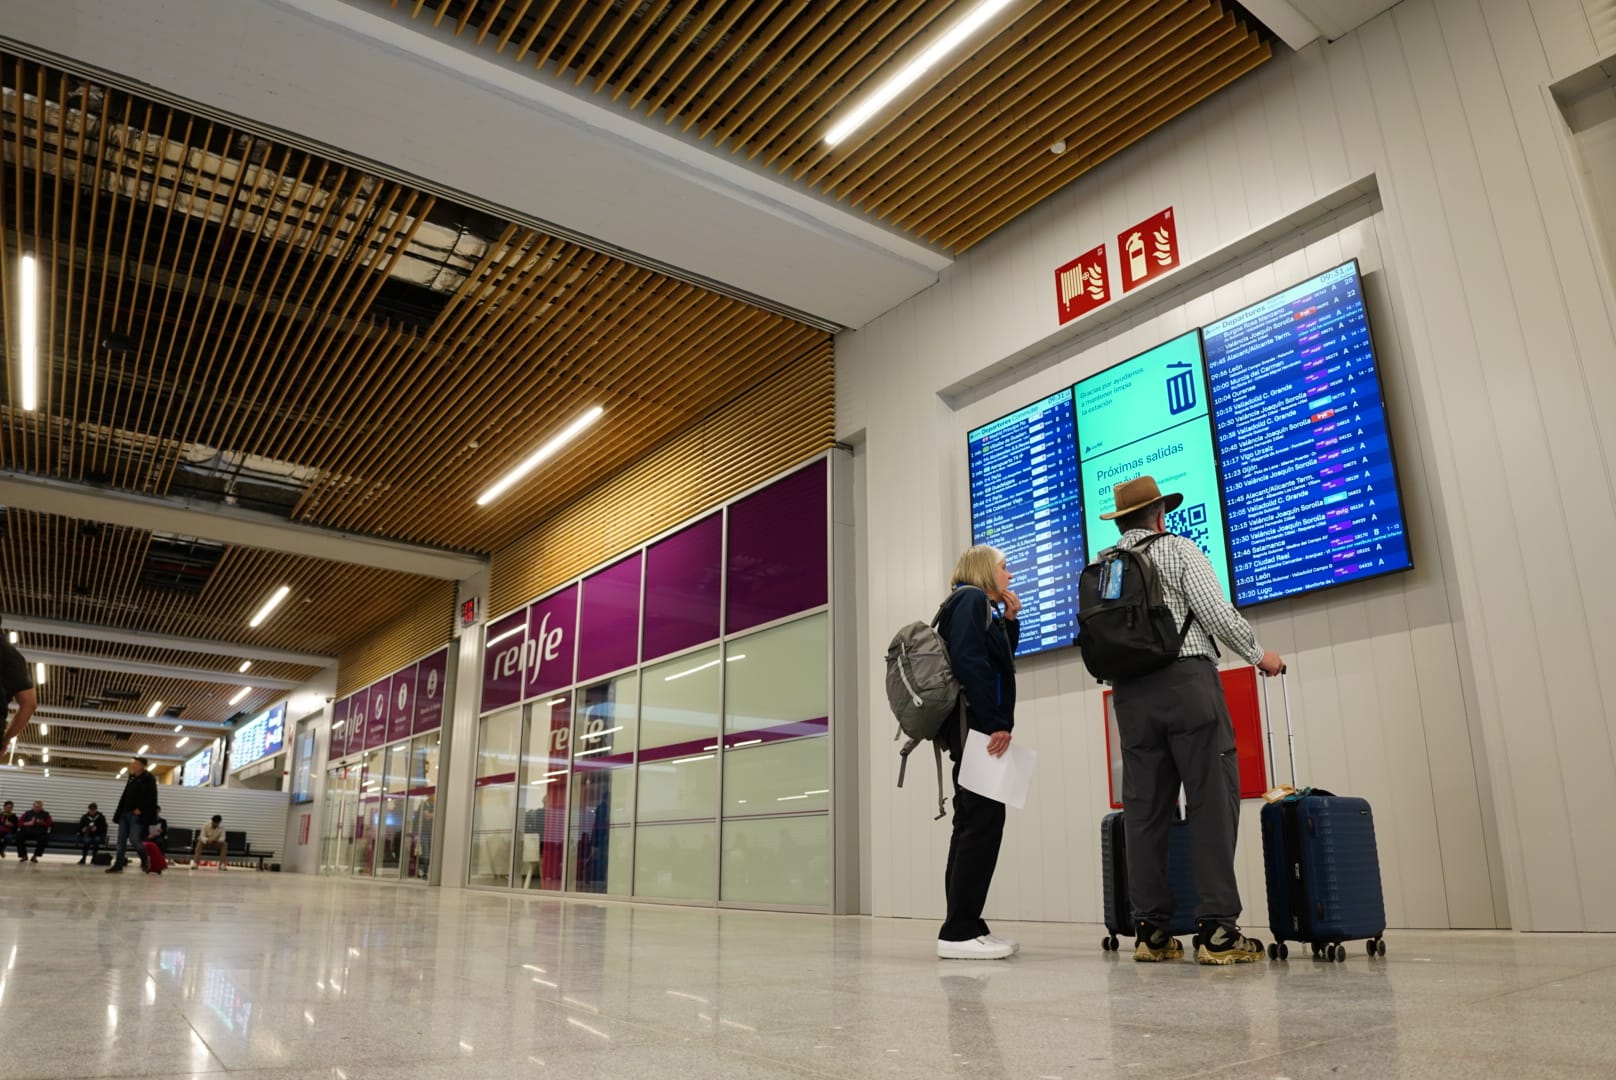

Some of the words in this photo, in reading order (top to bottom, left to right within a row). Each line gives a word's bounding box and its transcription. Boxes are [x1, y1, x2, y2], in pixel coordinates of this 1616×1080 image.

[1222, 305, 1266, 330] Departures
[1224, 326, 1243, 339] Burgos
[1244, 319, 1258, 330] Rosa
[1258, 307, 1285, 324] Manzano
[1331, 283, 1337, 291] A
[1249, 325, 1273, 340] Joaquín
[1273, 316, 1295, 330] Sorolla
[1334, 296, 1340, 304] A
[1346, 288, 1356, 298] 22
[1209, 357, 1226, 369] 09:45
[1274, 330, 1292, 342] Term.
[1336, 308, 1342, 316] A
[1211, 369, 1228, 381] 09:56
[1228, 364, 1243, 374] León
[1338, 321, 1344, 329] A
[1080, 386, 1101, 399] Gracias
[1102, 381, 1112, 392] por
[1114, 367, 1144, 388] ayudarnos
[1213, 381, 1230, 393] 10:00
[1230, 374, 1250, 386] Murcia
[1250, 368, 1260, 378] del
[1260, 360, 1285, 374] Carmen
[1340, 334, 1347, 342] A
[1214, 394, 1232, 405] 10:04
[1232, 385, 1256, 399] Ourense
[1343, 347, 1349, 355] A
[1082, 407, 1088, 416] la
[1088, 398, 1112, 414] estación
[1086, 390, 1112, 406] mantener
[1216, 406, 1233, 417] 10:15
[1234, 394, 1262, 410] Valladolid
[1270, 384, 1293, 397] Grande
[1345, 360, 1352, 368] A
[1217, 418, 1235, 430] 10:30
[1260, 400, 1285, 414] Joaquín
[1284, 392, 1308, 405] Sorolla
[1347, 373, 1354, 382] A
[1237, 420, 1266, 436] Valladolid
[1274, 410, 1297, 422] Grande
[1350, 387, 1356, 395] A
[1220, 443, 1238, 454] 10:45
[1264, 426, 1289, 440] Joaquín
[1288, 418, 1312, 431] Sorolla
[1352, 400, 1359, 408] A
[1222, 456, 1240, 467] 11:17
[1240, 452, 1254, 462] Vigo
[1254, 445, 1274, 457] Urzaiz
[1354, 414, 1361, 422] A
[1096, 457, 1144, 480] Próximas
[1146, 443, 1184, 464] salidas
[1224, 469, 1241, 480] 11:23
[1242, 464, 1258, 475] Gijón
[1357, 427, 1364, 436] A
[1225, 482, 1243, 493] 11:30
[1269, 466, 1294, 479] Joaquín
[1294, 459, 1318, 471] Sorolla
[1359, 441, 1366, 450] A
[1098, 485, 1111, 496] en
[1227, 495, 1245, 506] 11:45
[1296, 474, 1315, 485] Term.
[1361, 455, 1368, 464] A
[1228, 508, 1246, 519] 12:05
[1247, 499, 1277, 513] Valladolid
[1285, 490, 1309, 502] Grande
[1364, 470, 1371, 478] A
[1230, 521, 1248, 532] 12:15
[1274, 507, 1300, 519] Joaquín
[1300, 500, 1324, 512] Sorolla
[1366, 484, 1373, 493] A
[1231, 535, 1249, 546] 12:30
[1276, 521, 1302, 533] Joaquín
[1302, 514, 1326, 526] Sorolla
[1368, 498, 1375, 507] A
[1233, 548, 1251, 559] 12:46
[1251, 540, 1286, 554] Salamanca
[1371, 513, 1378, 521] A
[1234, 562, 1253, 572] 12:57
[1253, 556, 1276, 568] Ciudad
[1276, 552, 1291, 562] Real
[1236, 576, 1255, 586] 13:03
[1255, 573, 1271, 582] León
[1376, 543, 1382, 551] A
[1238, 590, 1256, 600] 13:20
[1257, 587, 1273, 596] Lugo
[1378, 558, 1385, 566] A
[492, 612, 563, 685] renfe
[334, 702, 363, 747] renfe
